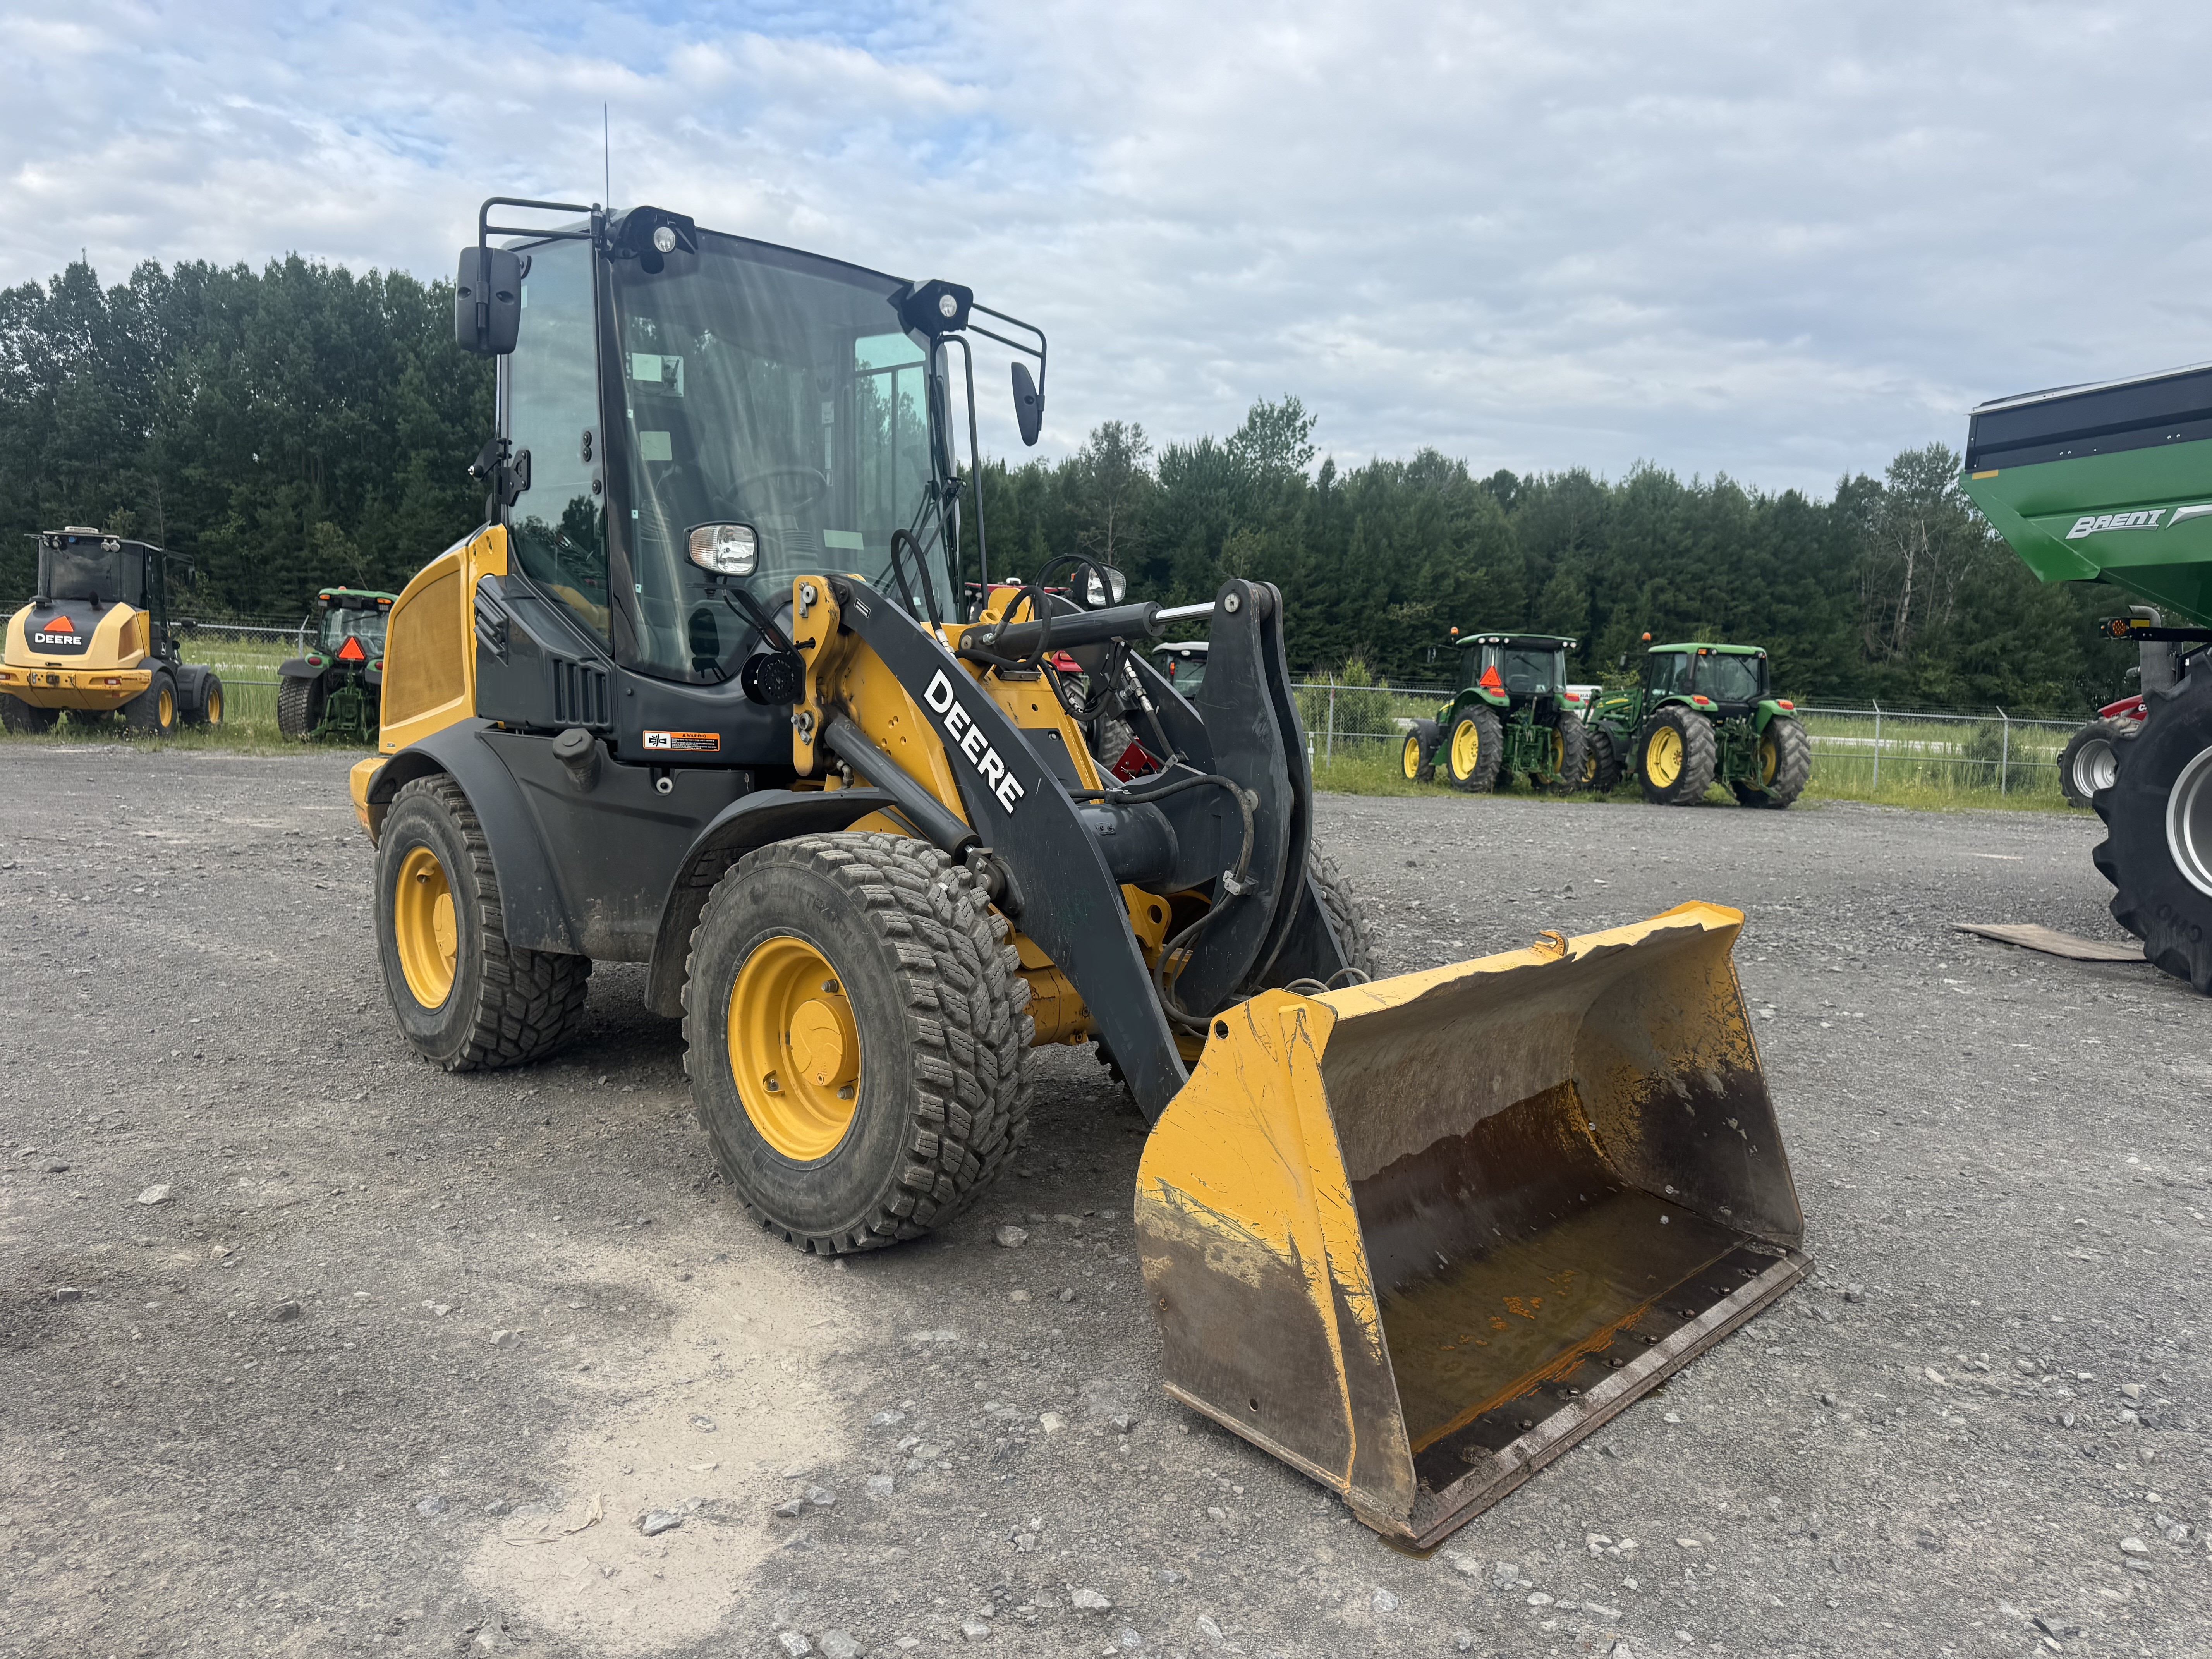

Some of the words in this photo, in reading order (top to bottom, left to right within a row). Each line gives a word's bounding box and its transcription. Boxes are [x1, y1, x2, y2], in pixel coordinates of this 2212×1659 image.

[2065, 509, 2167, 539] BRENT
[35, 633, 82, 645] DEERE
[924, 668, 1025, 814] DEERE
